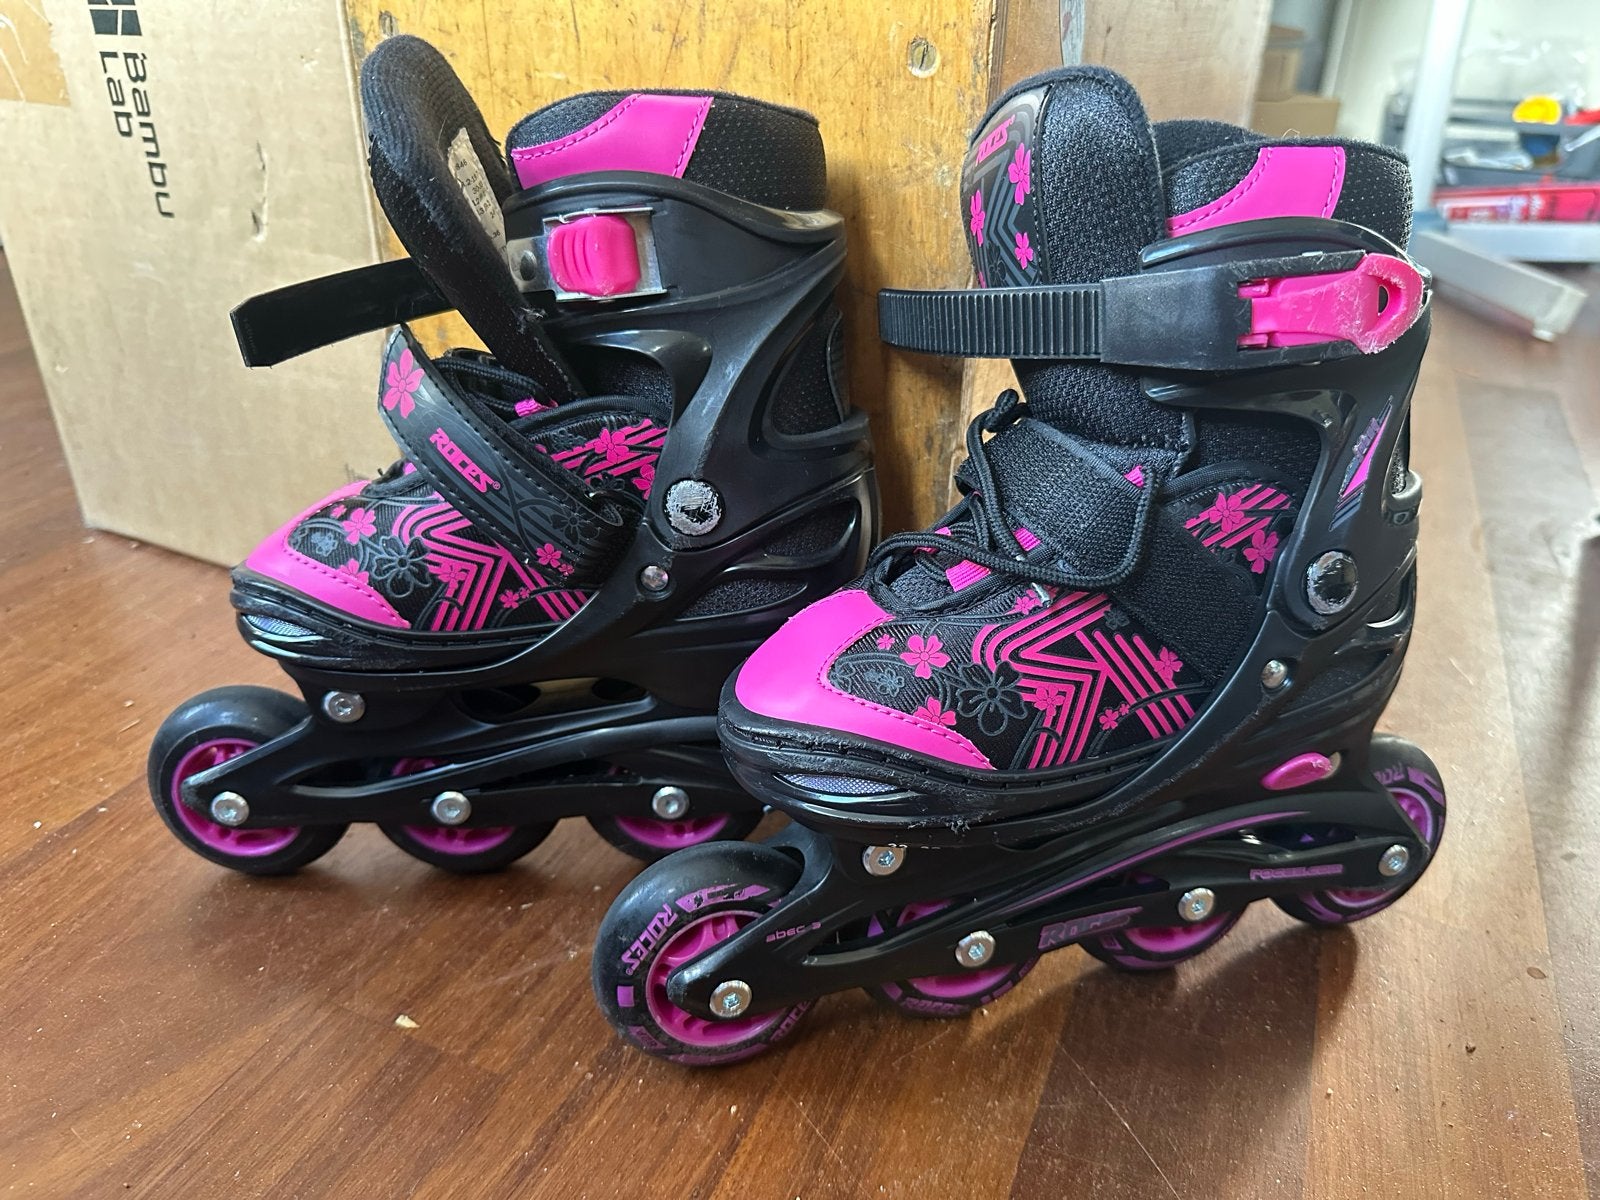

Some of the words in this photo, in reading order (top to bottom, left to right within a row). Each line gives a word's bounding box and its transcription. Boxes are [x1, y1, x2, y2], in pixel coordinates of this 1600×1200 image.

[99, 51, 133, 138] Lab
[123, 52, 174, 218] Bambu
[430, 427, 495, 493] ROCES
[621, 903, 679, 970] ROCES
